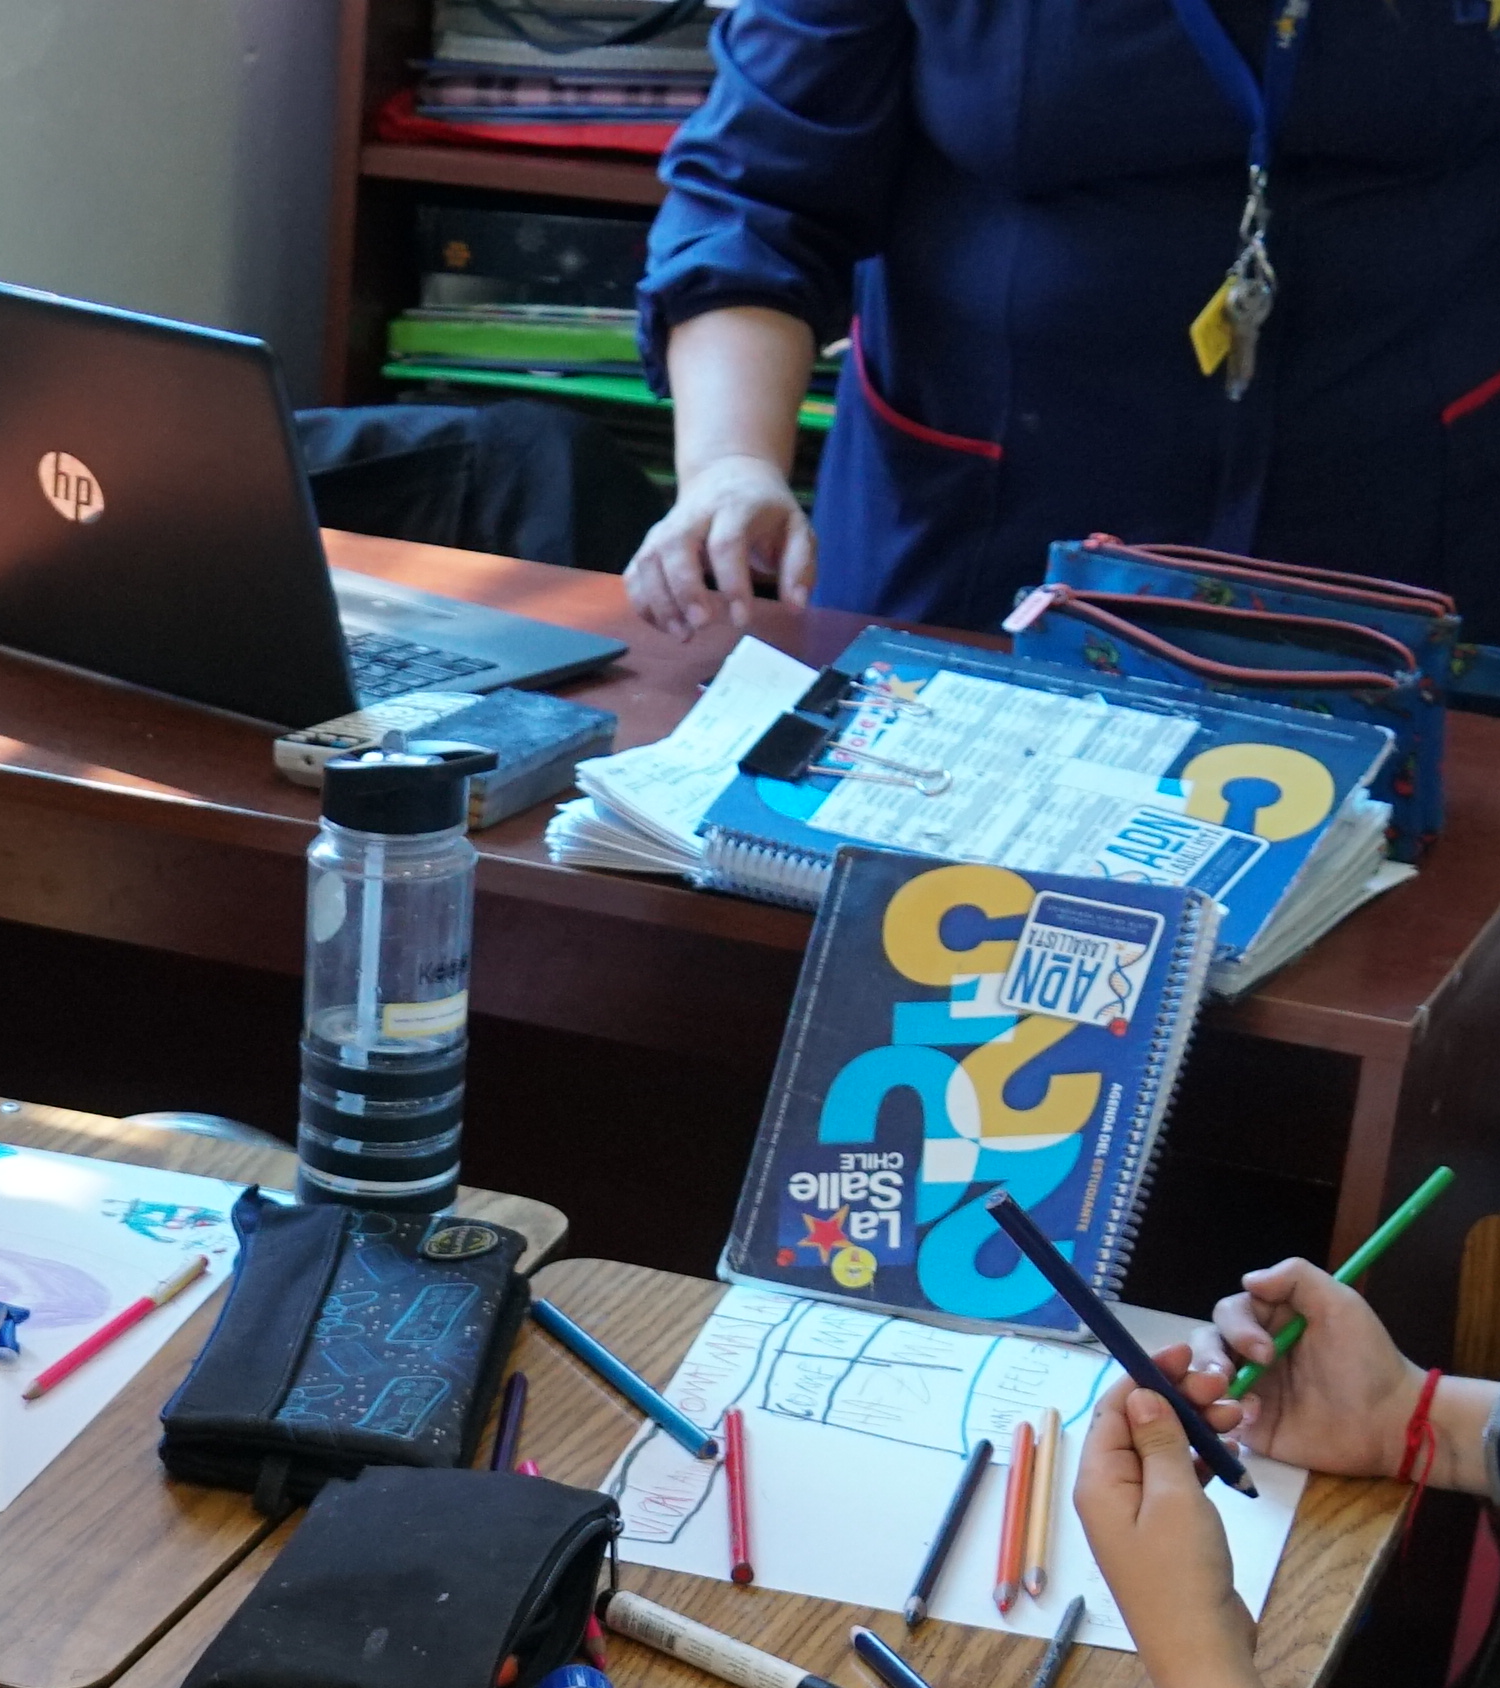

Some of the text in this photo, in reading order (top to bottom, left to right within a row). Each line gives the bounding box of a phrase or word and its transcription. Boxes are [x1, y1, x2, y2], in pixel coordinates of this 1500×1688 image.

[51, 452, 95, 522] hp
[1105, 810, 1202, 870] ADN
[1007, 946, 1103, 1015] ADN
[1102, 1082, 1124, 1133] AGENDA
[838, 1152, 905, 1172] CHILE
[1094, 1133, 1113, 1157] DEL
[787, 1170, 905, 1210] Salle
[850, 1210, 901, 1249] La
